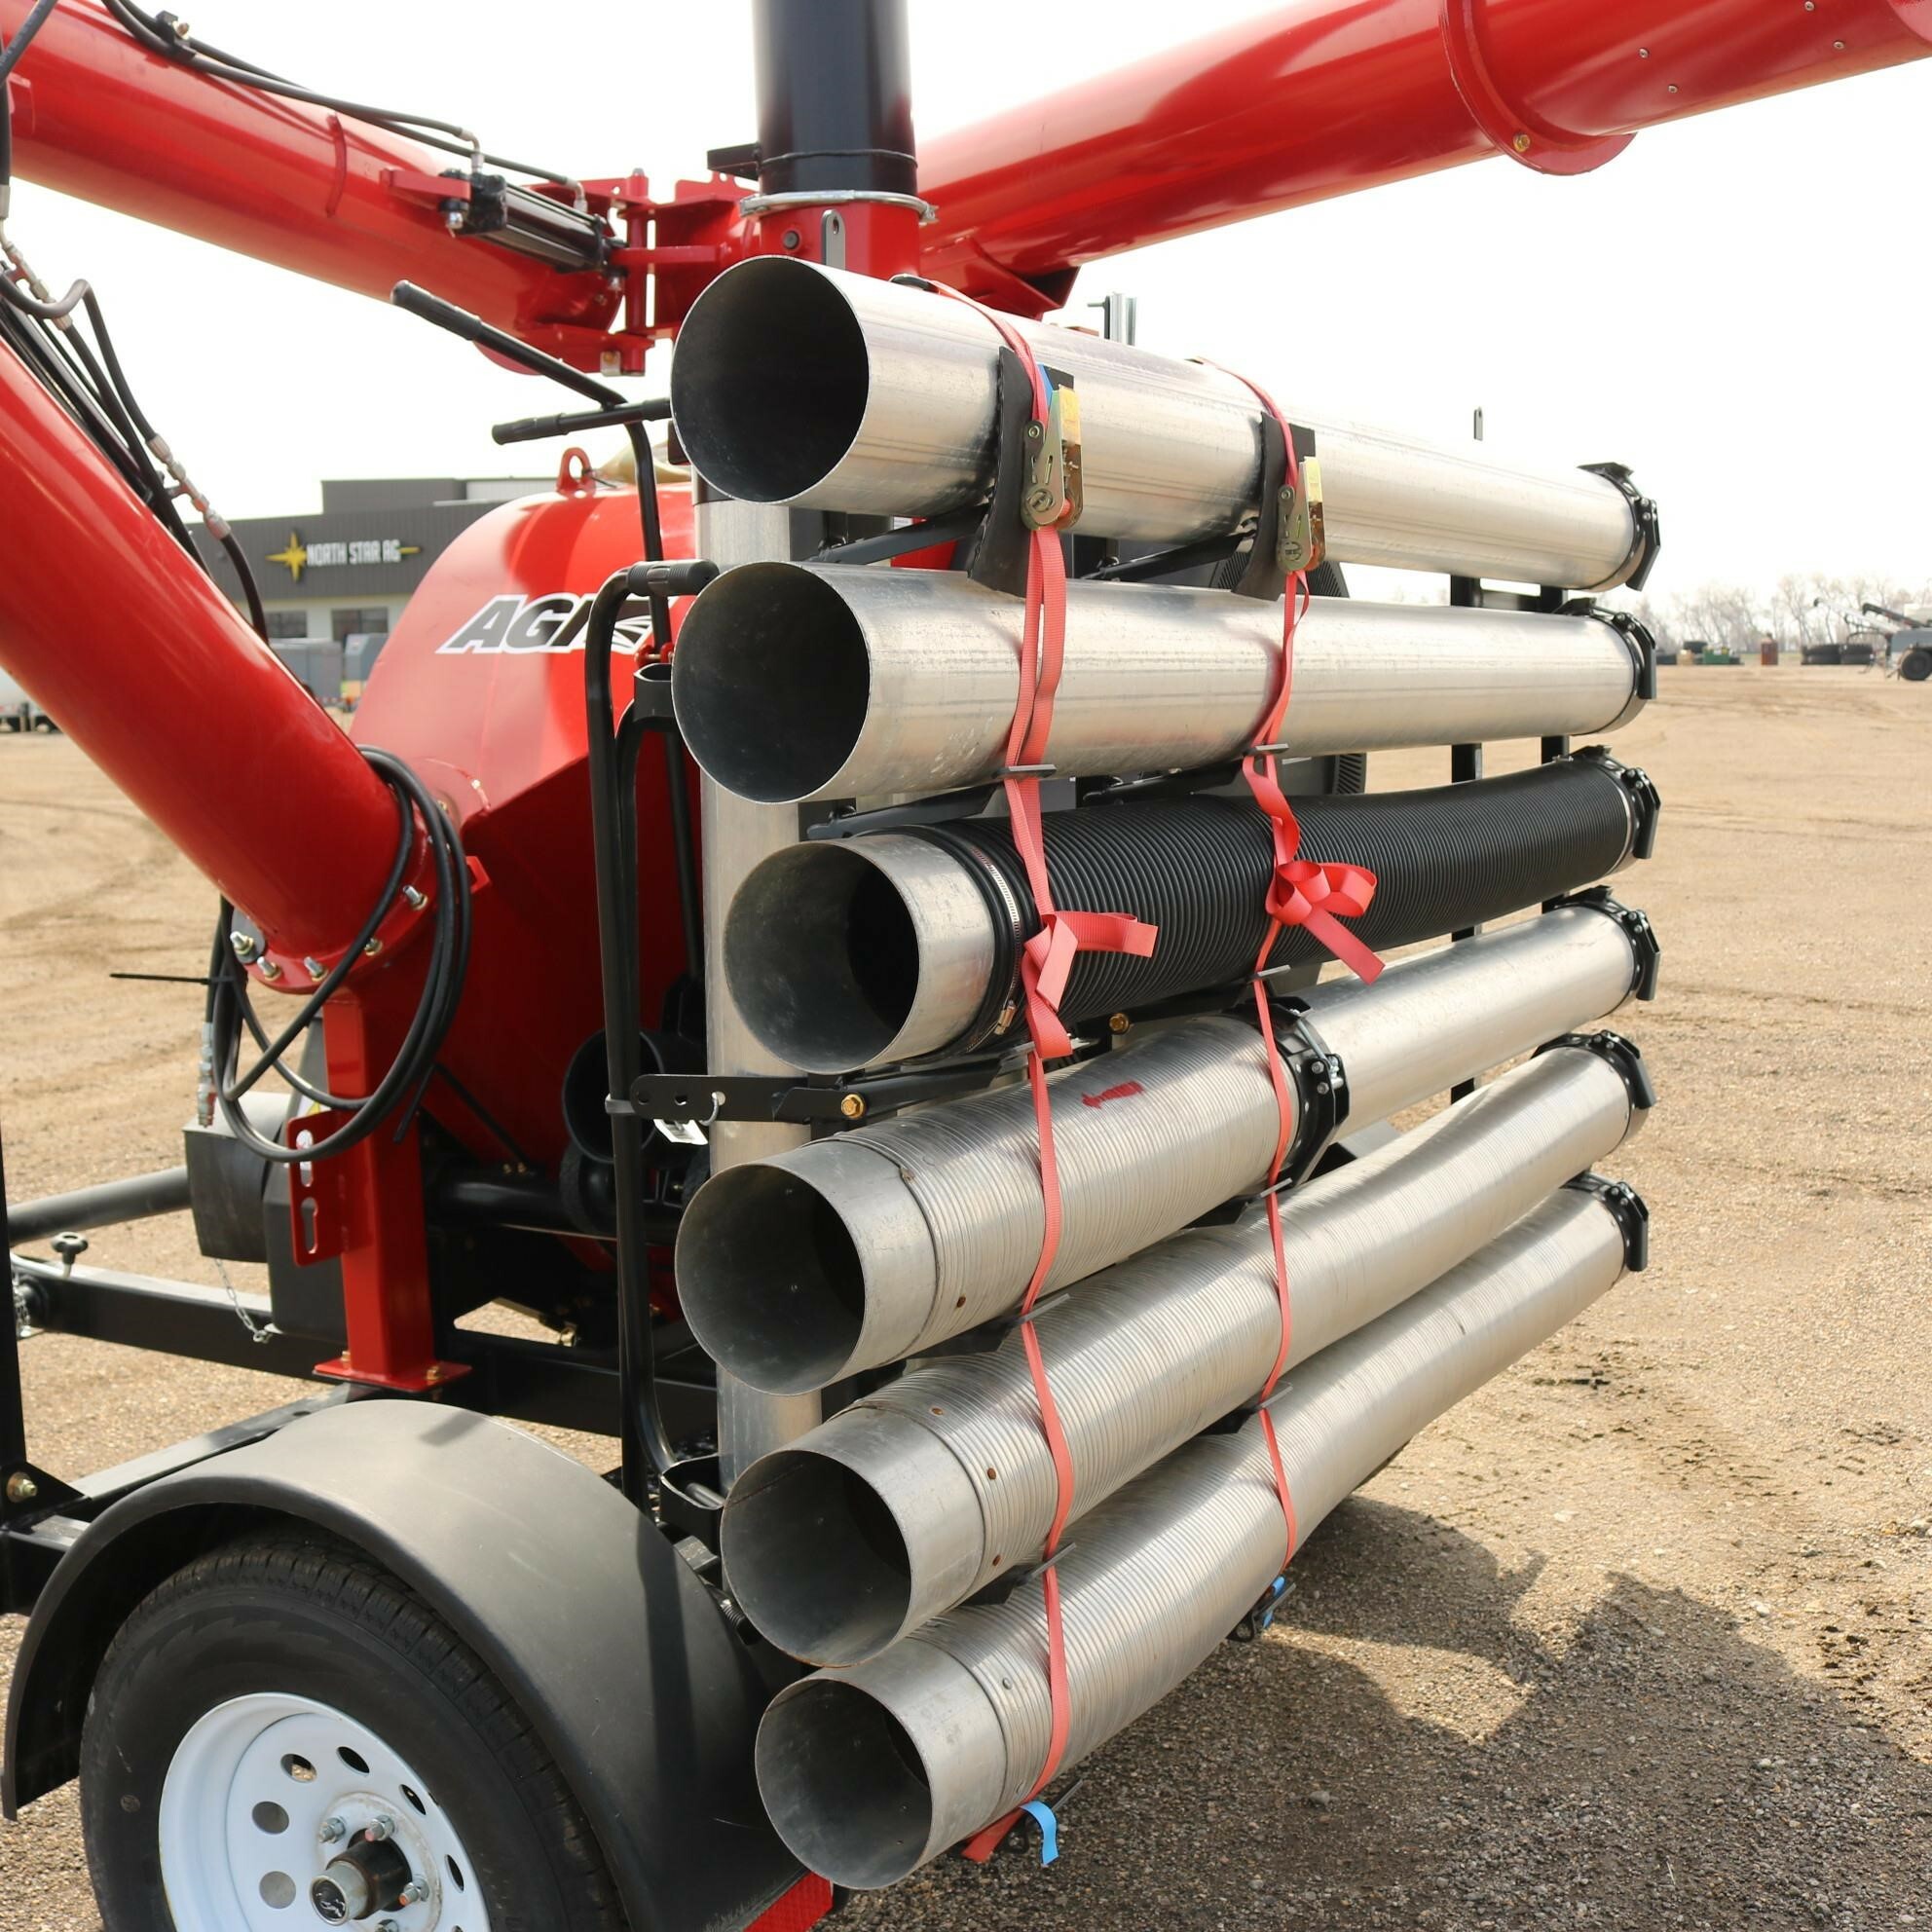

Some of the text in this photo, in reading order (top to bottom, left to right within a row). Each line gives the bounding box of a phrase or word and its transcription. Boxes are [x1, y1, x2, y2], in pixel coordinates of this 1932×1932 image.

[307, 539, 401, 566] NORTH STAR AG
